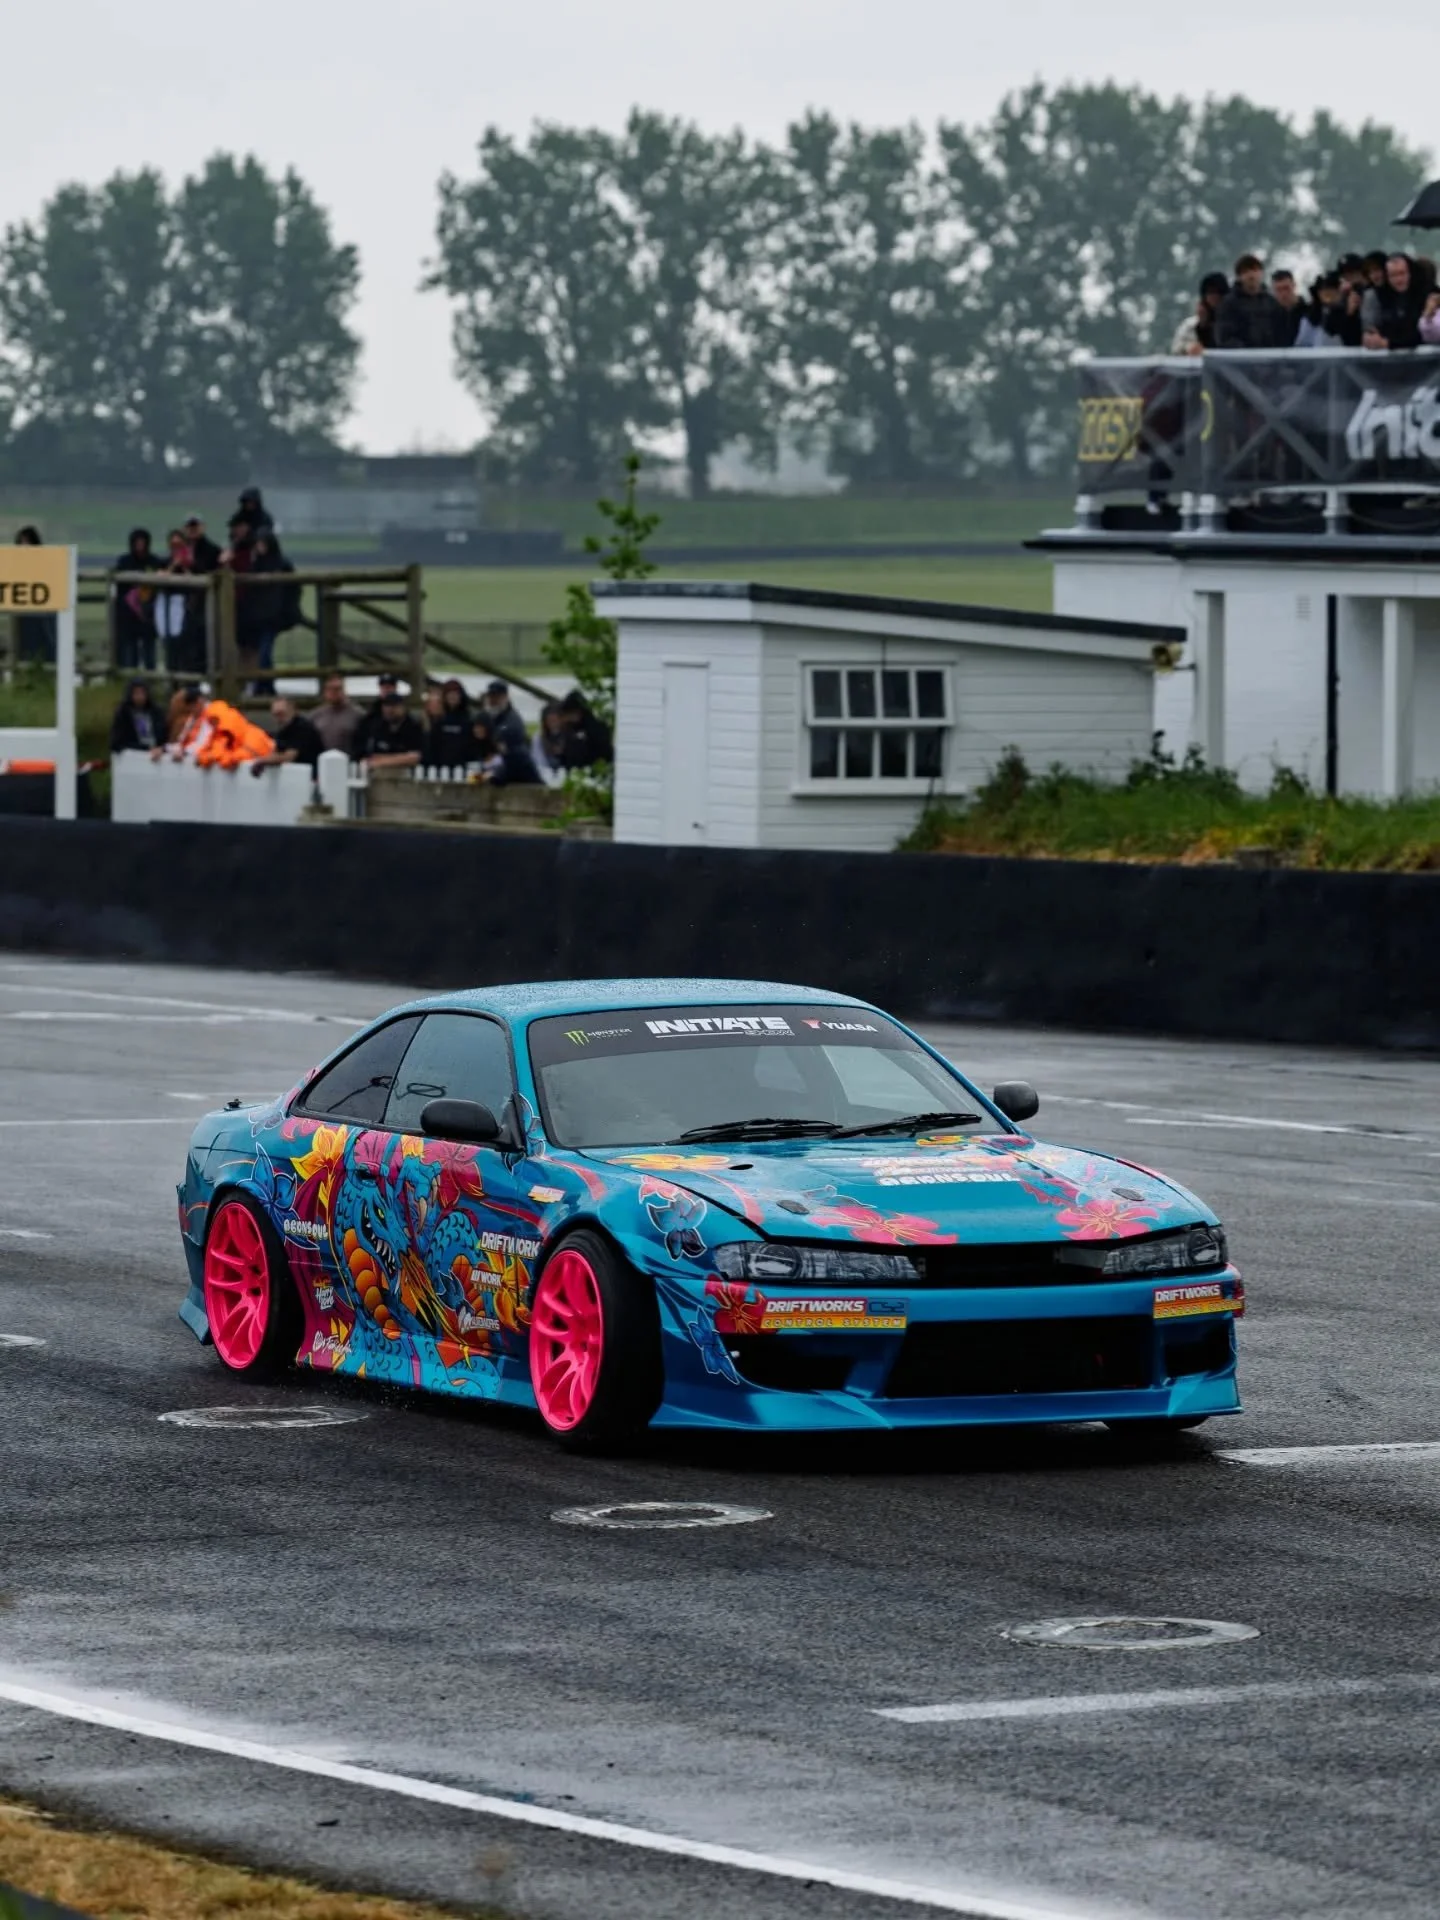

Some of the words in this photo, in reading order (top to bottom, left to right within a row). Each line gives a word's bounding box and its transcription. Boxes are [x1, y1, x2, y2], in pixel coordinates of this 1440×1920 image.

[0, 582, 50, 606] TED
[644, 1017, 791, 1034] INITIATE
[822, 1022, 879, 1033] YUASA
[1154, 1285, 1220, 1303] DRIFTWORKS
[765, 1300, 865, 1313] DRIFTWORKS
[763, 1317, 833, 1327] CONTROL
[843, 1317, 901, 1327] SYSTEM
